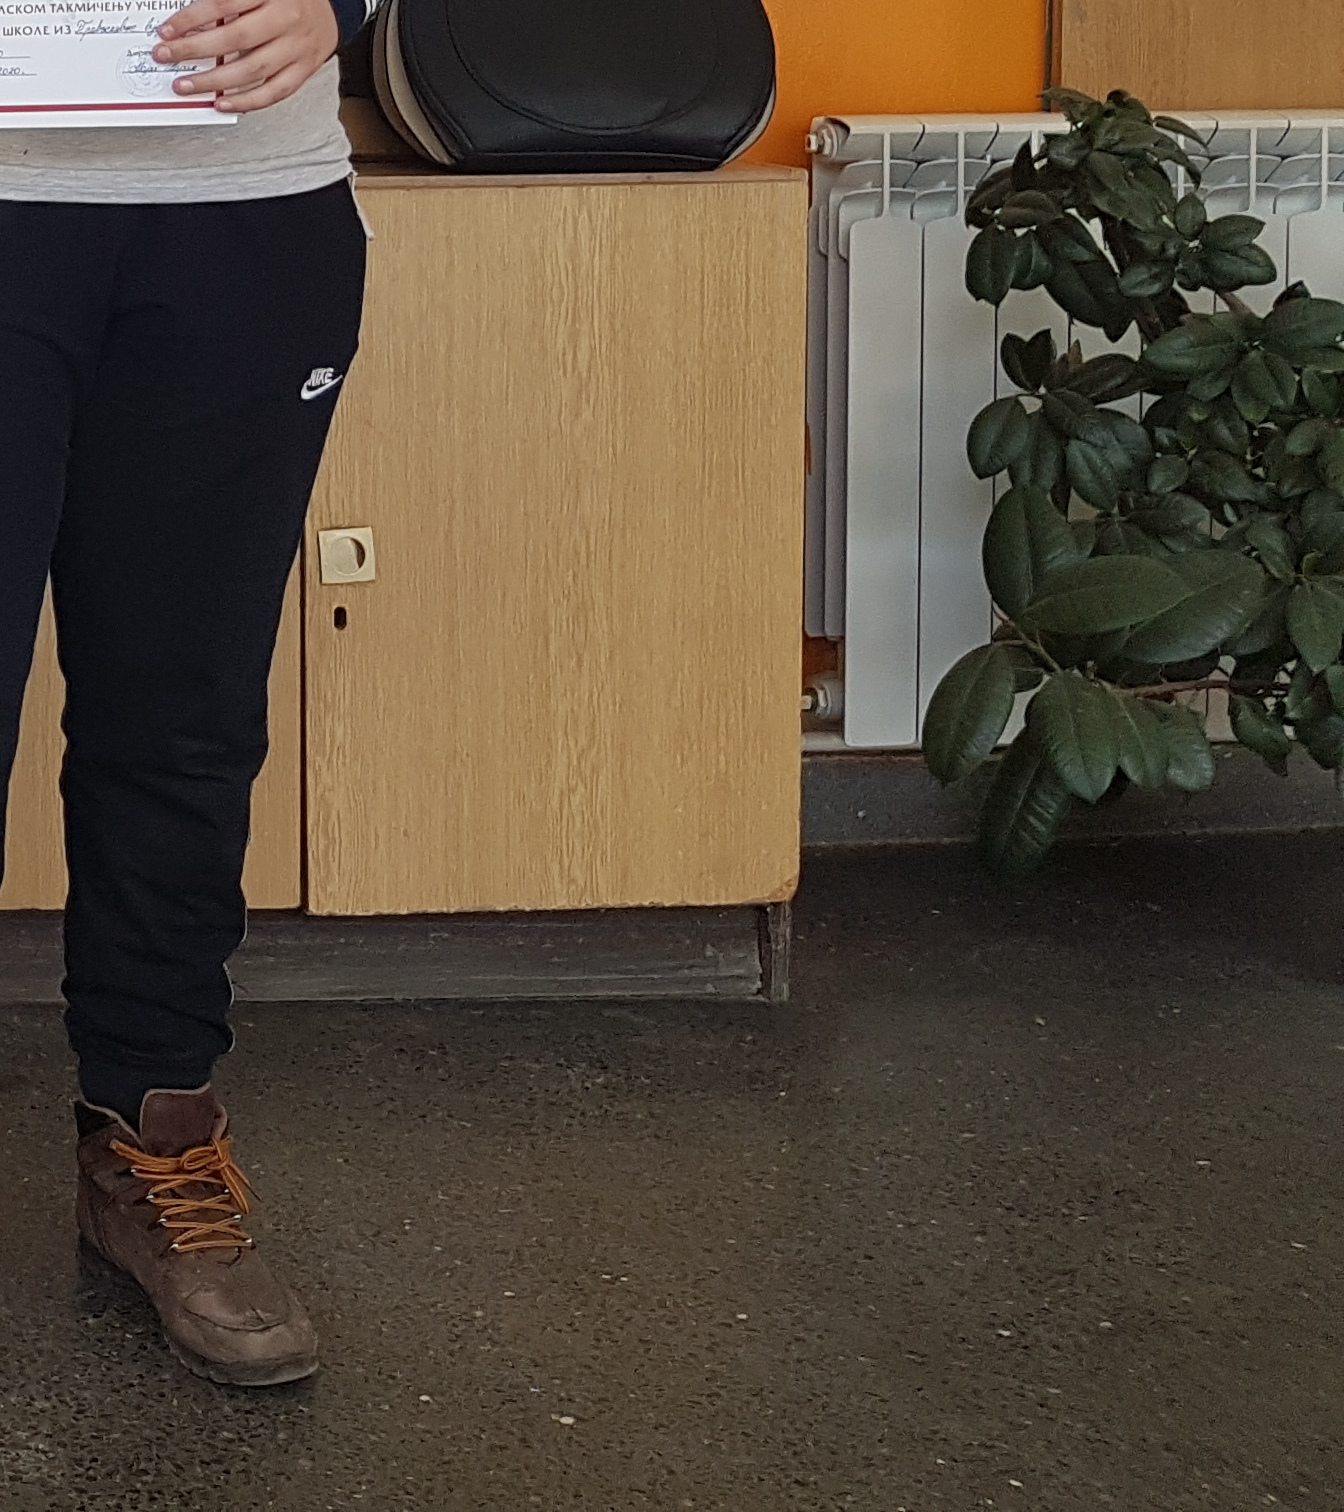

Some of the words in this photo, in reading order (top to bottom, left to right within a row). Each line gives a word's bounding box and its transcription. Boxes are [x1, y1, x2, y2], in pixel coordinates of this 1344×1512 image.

[49, 1, 132, 14] ТАКМИЧЕЊУ
[2, 25, 50, 37] ШКОЛЕ
[54, 24, 72, 35] ИЗ
